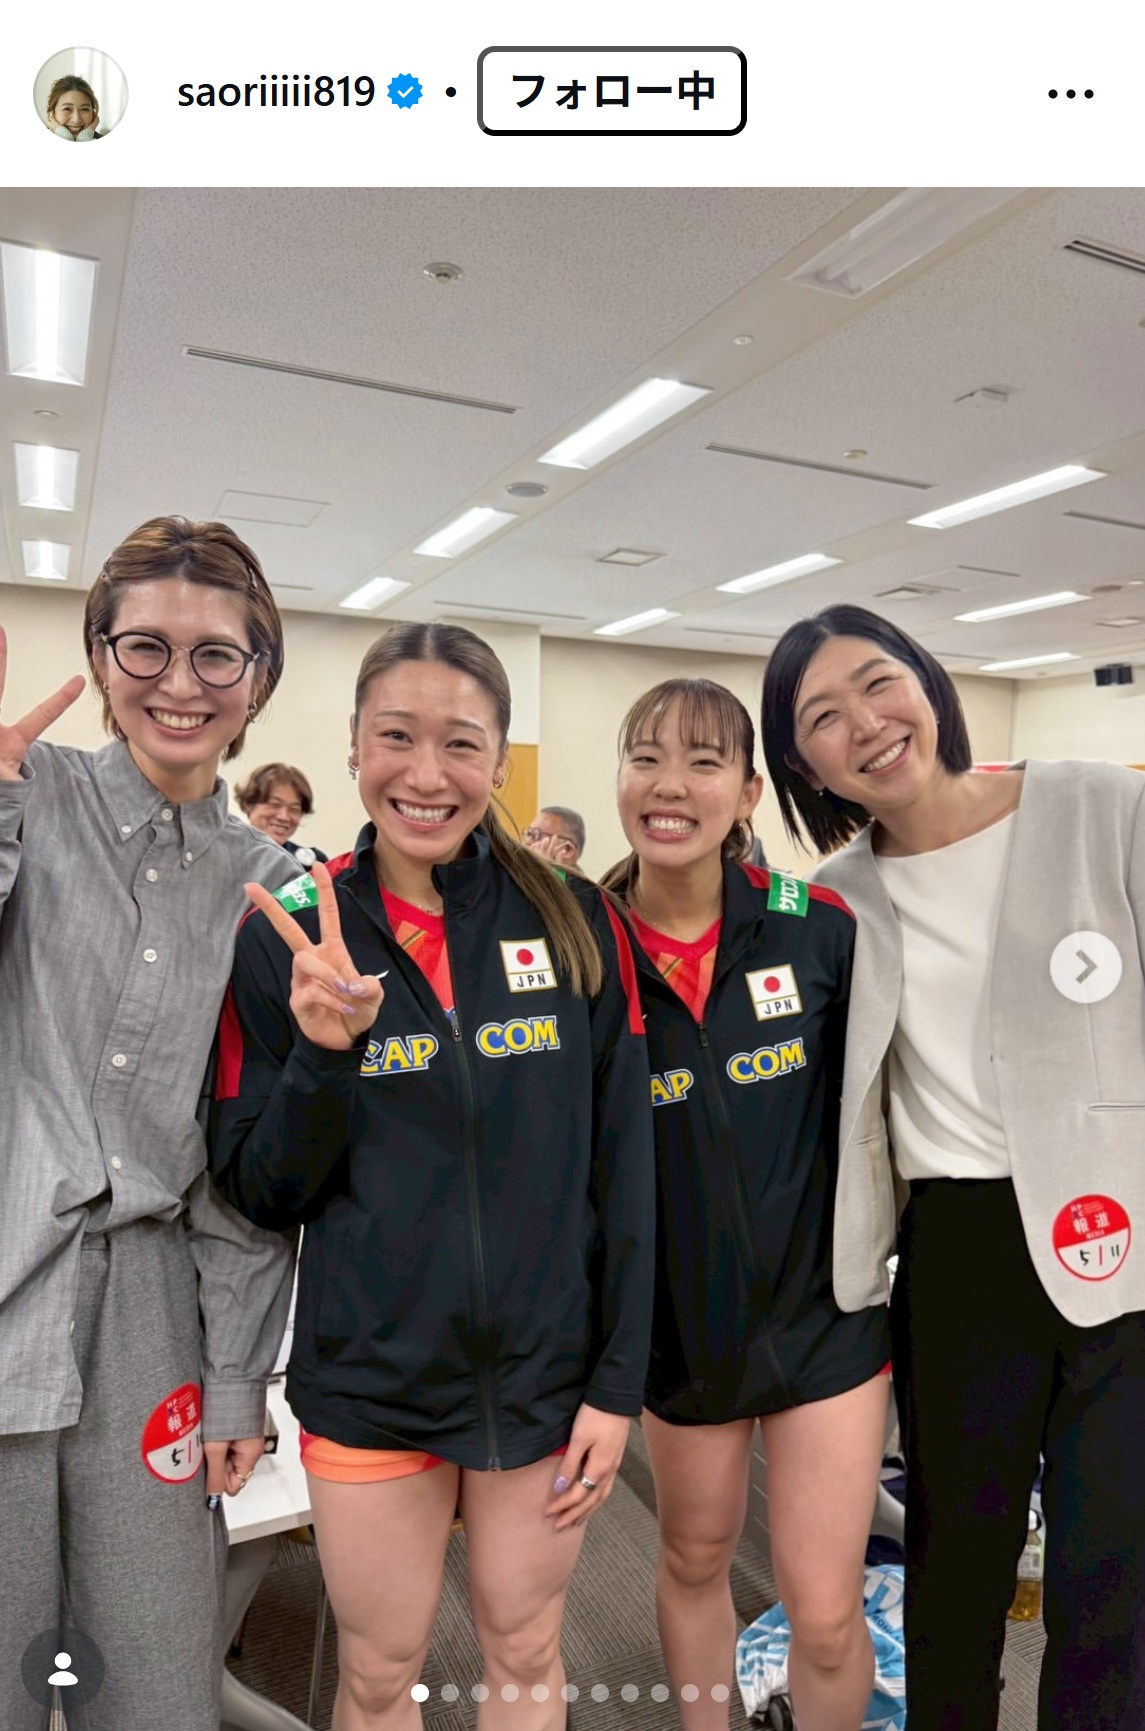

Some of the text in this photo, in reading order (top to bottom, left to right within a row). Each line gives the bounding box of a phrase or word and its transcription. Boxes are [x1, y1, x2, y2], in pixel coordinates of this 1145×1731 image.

[516, 973, 546, 988] JPN
[764, 999, 793, 1015] JPN
[476, 1016, 561, 1058] COM
[651, 1036, 807, 1107] AP COM
